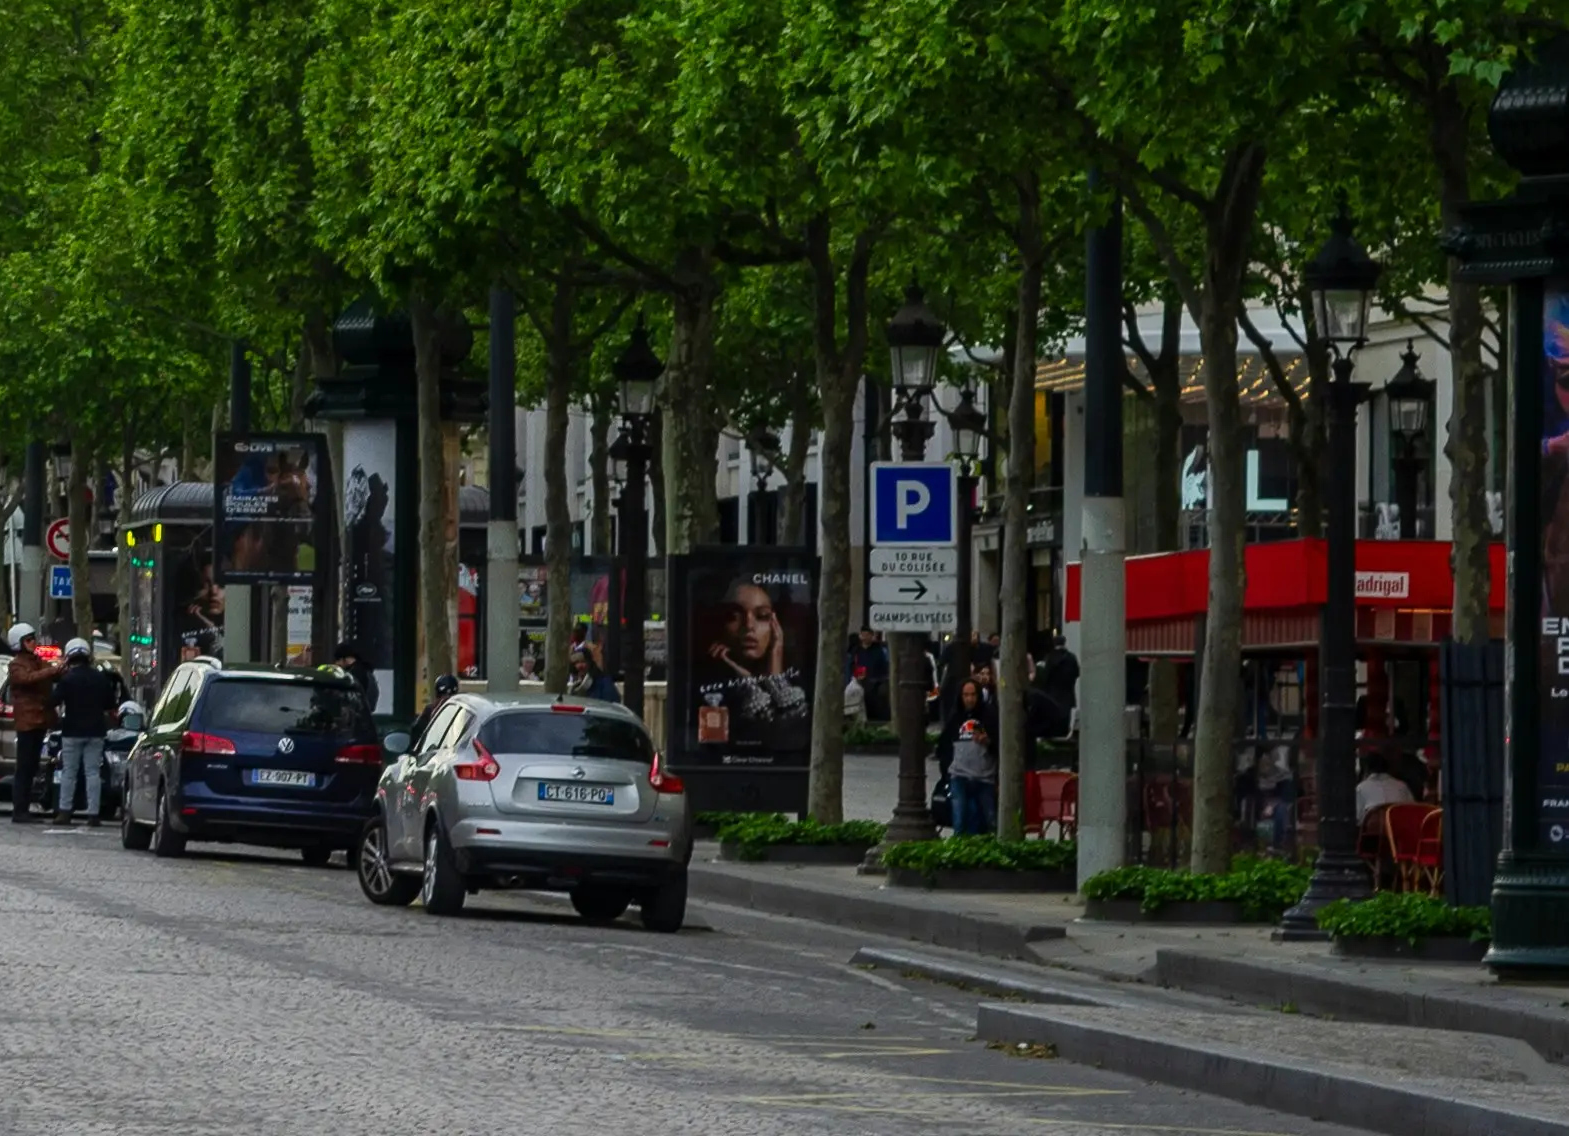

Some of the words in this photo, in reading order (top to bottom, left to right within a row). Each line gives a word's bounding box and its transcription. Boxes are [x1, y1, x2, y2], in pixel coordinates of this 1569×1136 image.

[896, 480, 930, 530] P
[895, 552, 908, 561] 10
[911, 552, 933, 561] RUE
[881, 562, 896, 572] DU
[900, 562, 946, 573] COLISÉE
[752, 573, 808, 585] CHANEL
[1356, 576, 1404, 597] adrigal
[873, 611, 954, 624] CHAMPS-ELYSÉES
